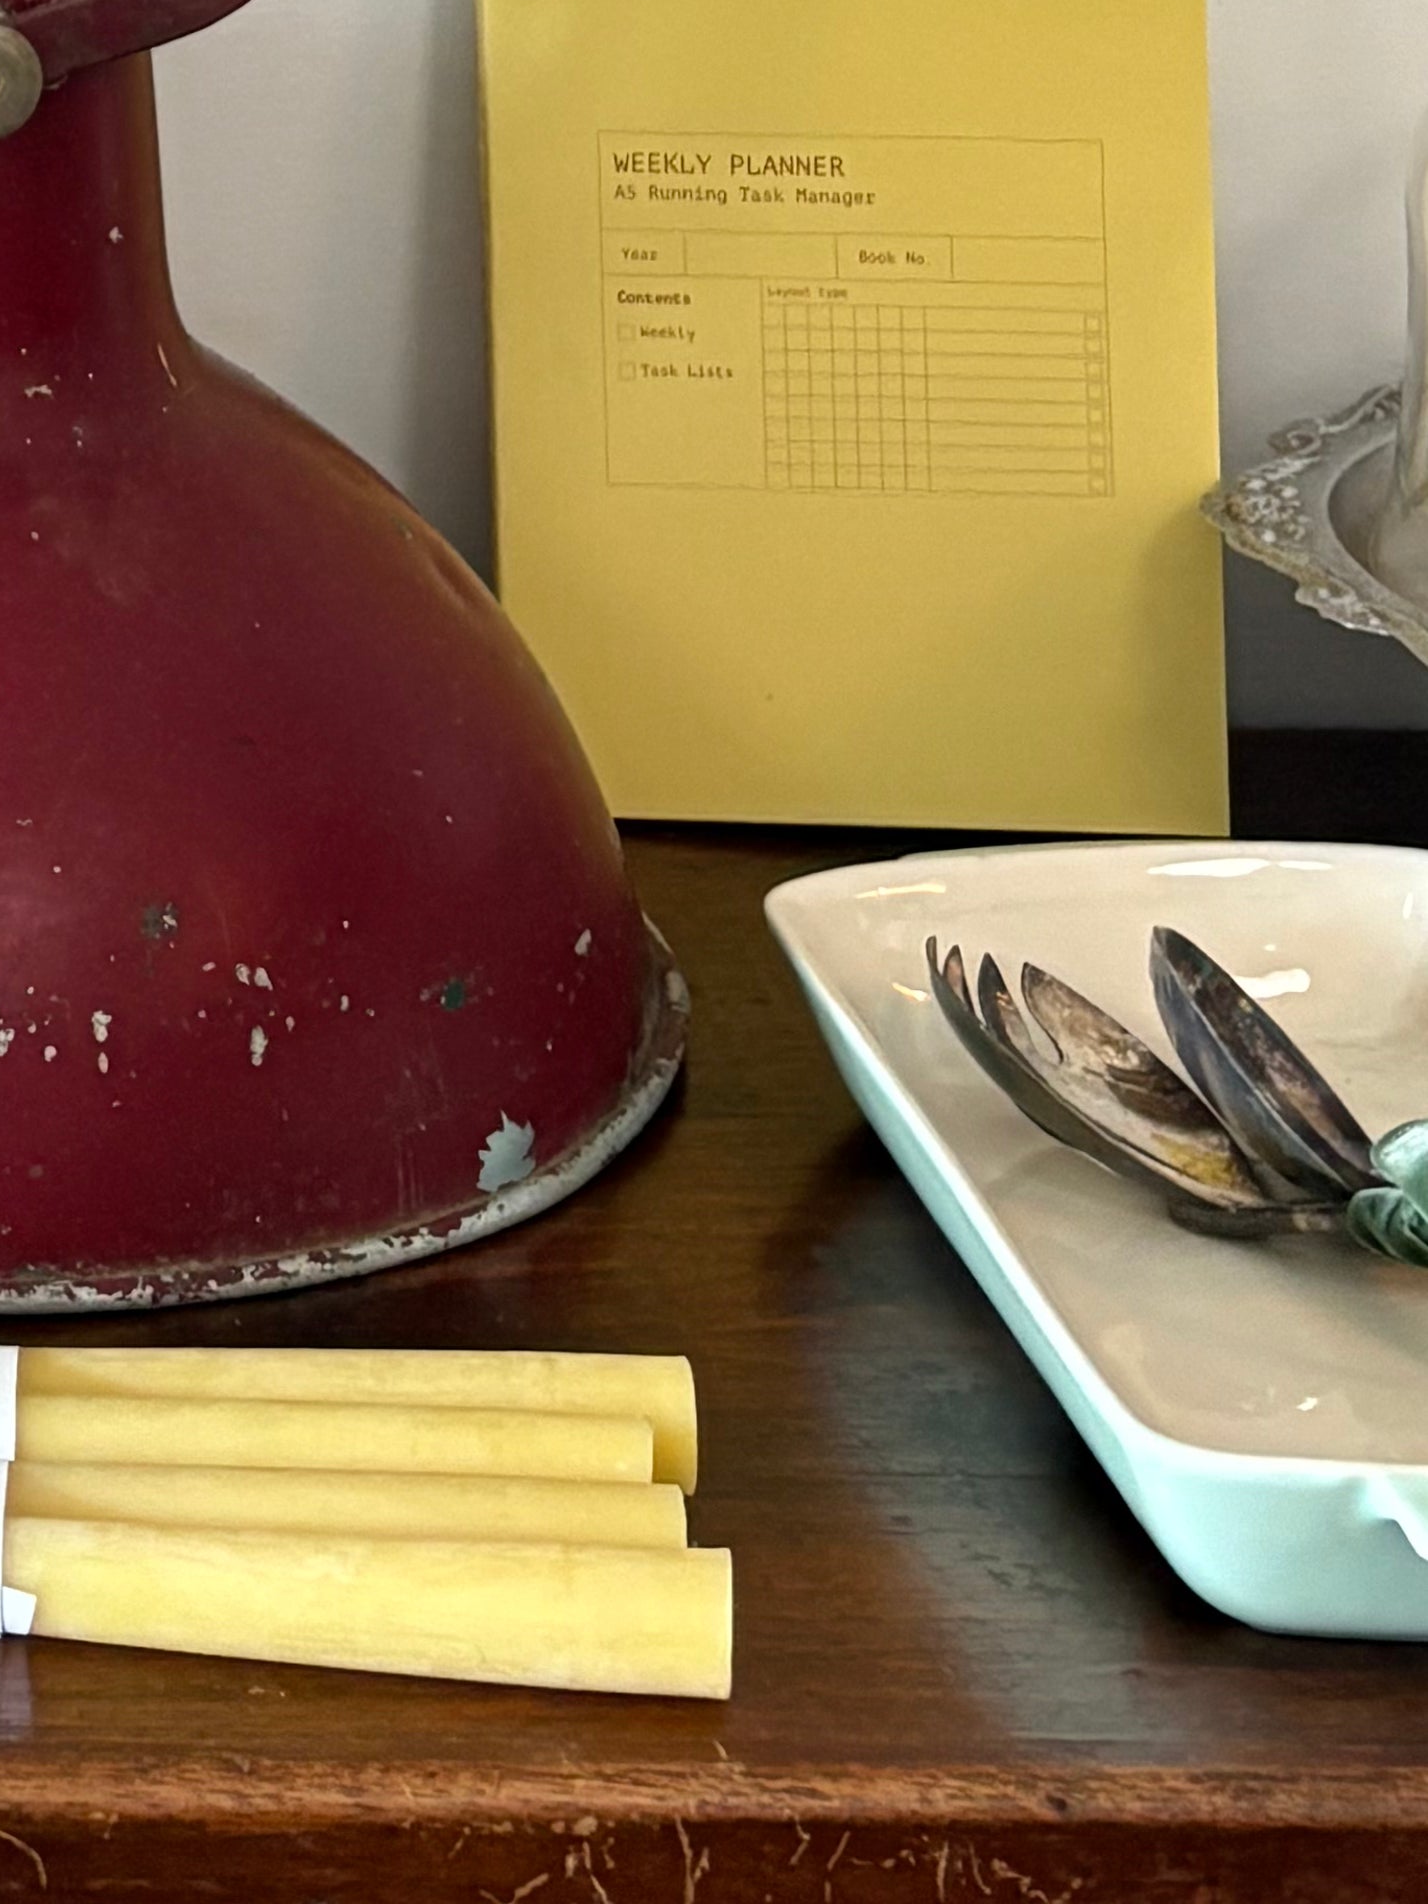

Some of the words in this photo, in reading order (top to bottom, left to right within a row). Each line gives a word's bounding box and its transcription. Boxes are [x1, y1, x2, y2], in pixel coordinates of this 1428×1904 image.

[612, 152, 712, 175] WEEKLY
[729, 154, 846, 178] PLANNER
[614, 184, 637, 200] A5
[648, 184, 727, 205] Running
[739, 186, 785, 204] Task
[796, 188, 876, 208] Manager
